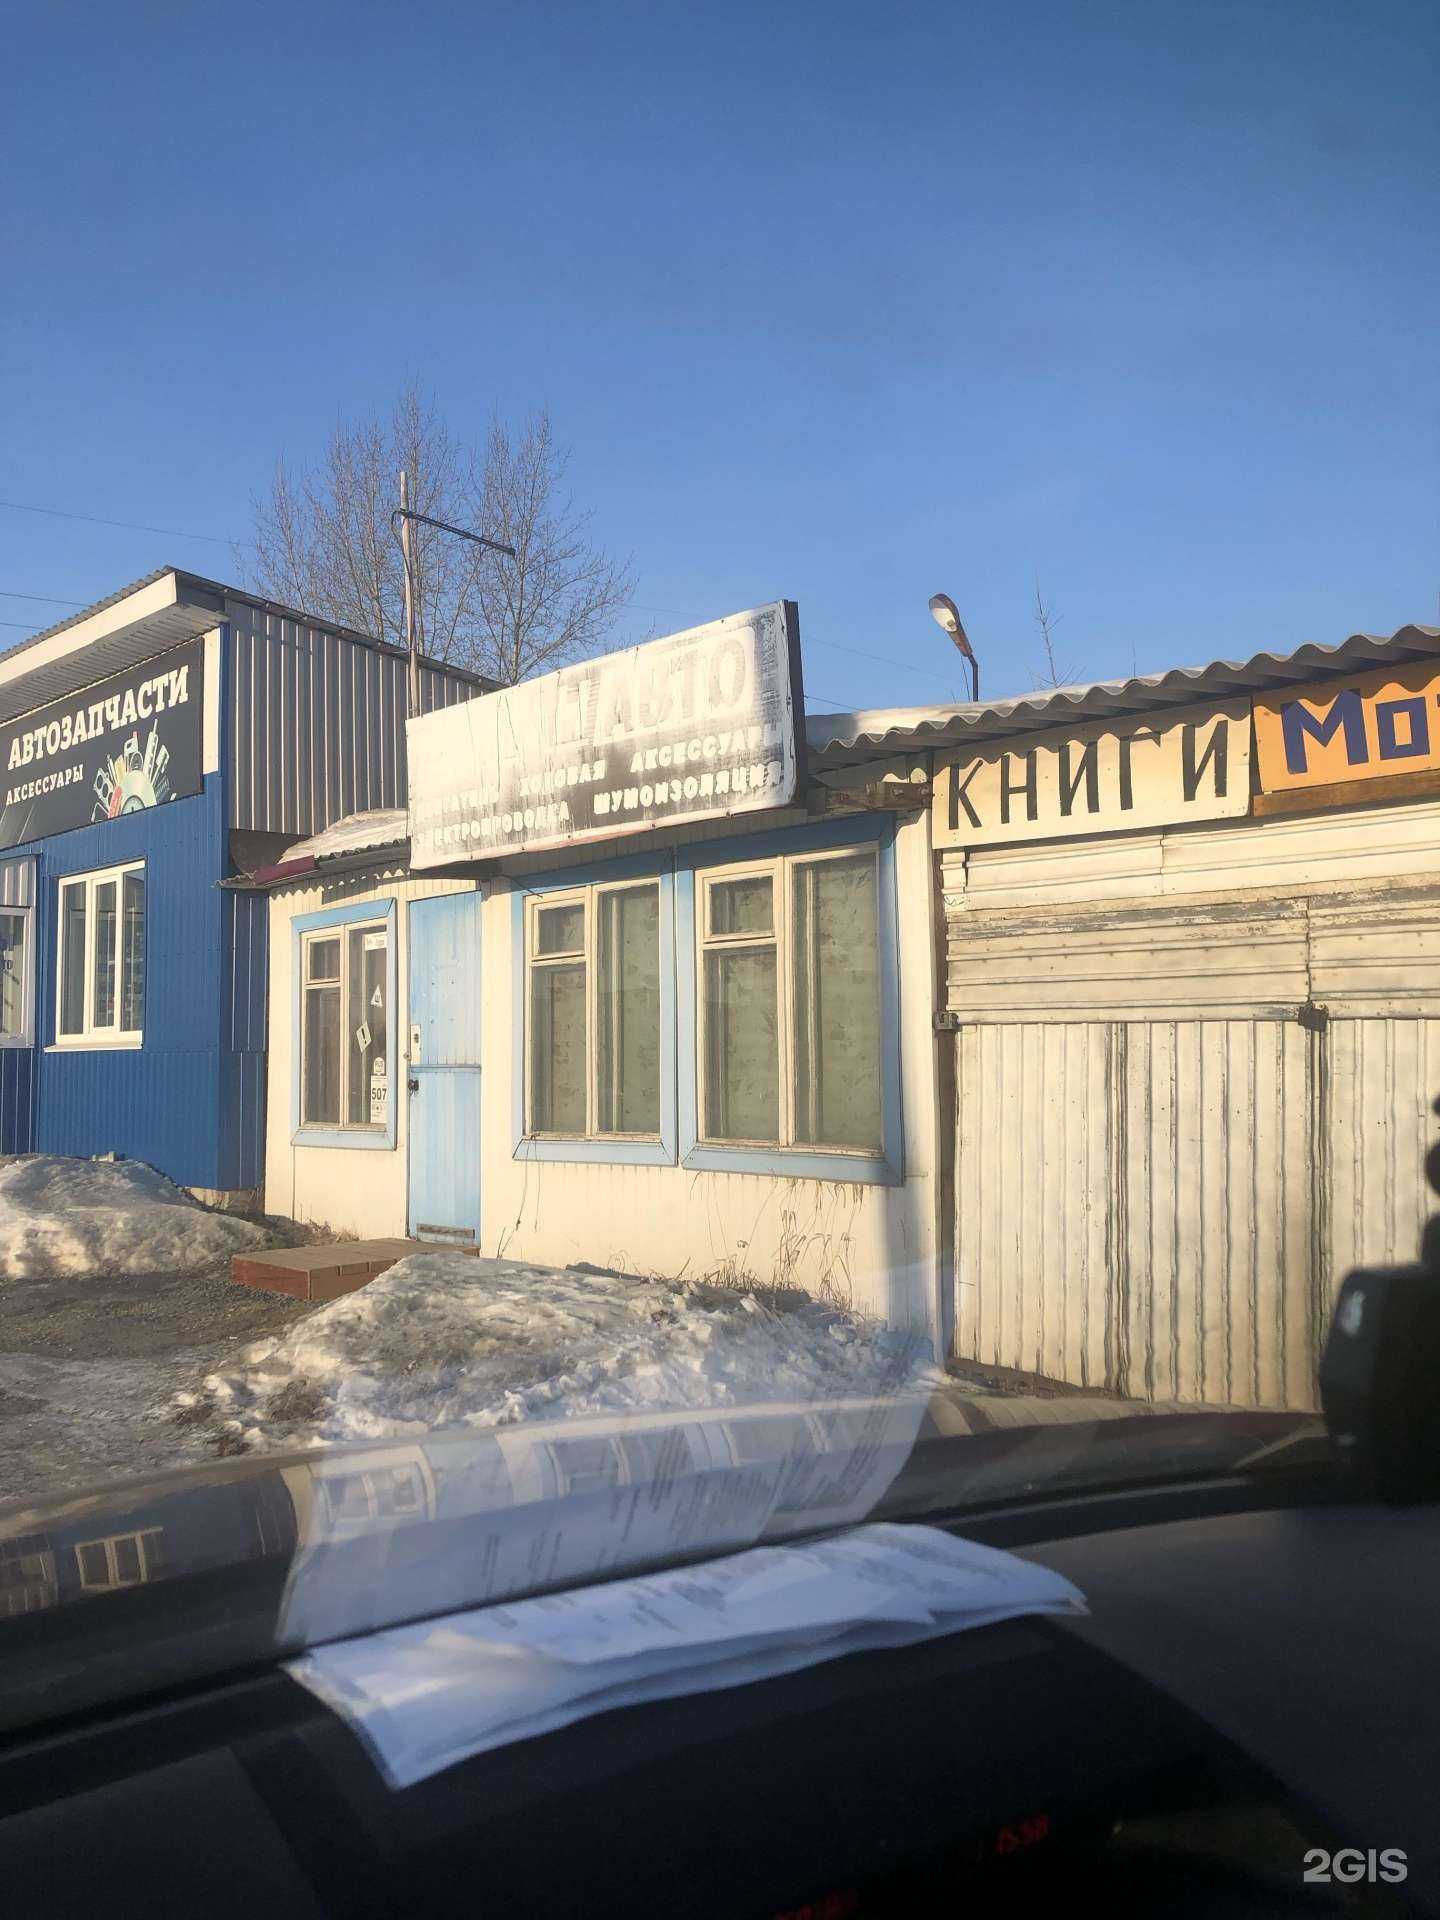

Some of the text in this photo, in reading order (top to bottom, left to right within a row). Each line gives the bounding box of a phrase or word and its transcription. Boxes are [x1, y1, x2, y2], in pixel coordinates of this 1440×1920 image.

[8, 665, 189, 770] АВТОЗАПЧАСТИ
[6, 764, 84, 806] АКСЕССУАРЫ
[593, 761, 783, 815] ШУМОИЗОЛЯЦИЯ
[948, 719, 1229, 831] КНИГИ
